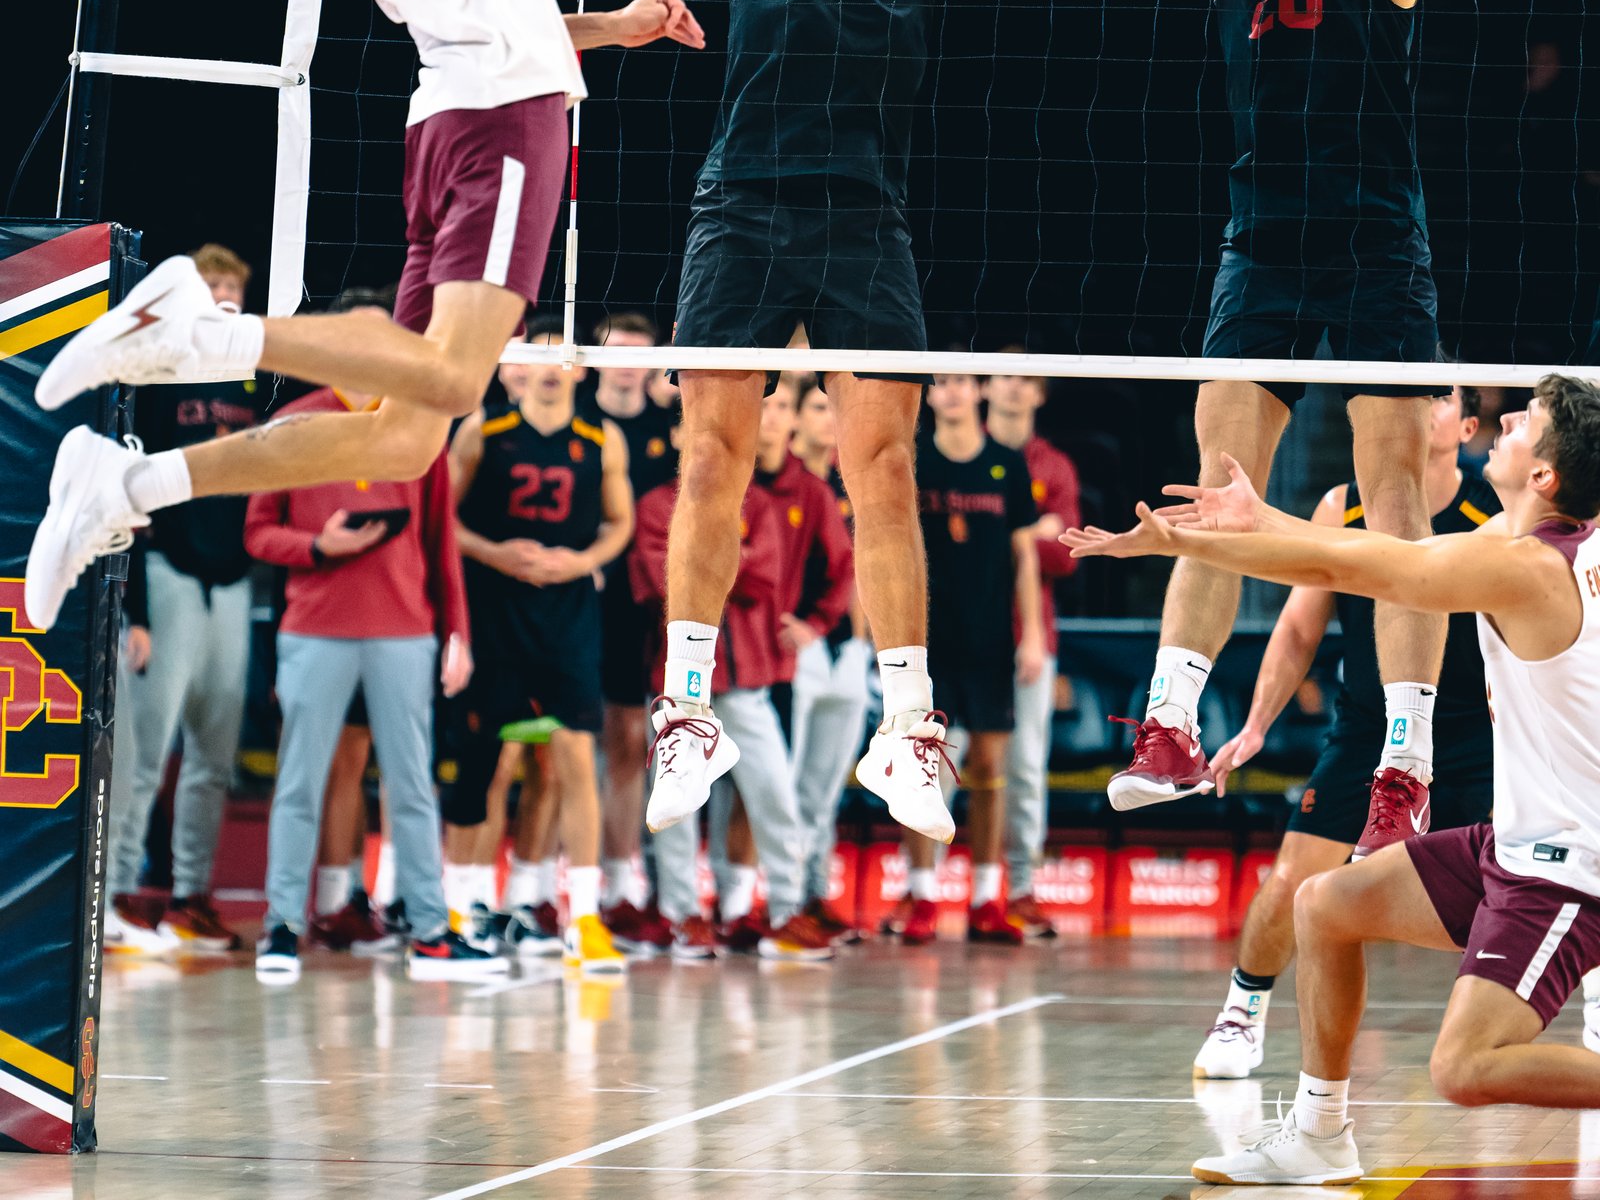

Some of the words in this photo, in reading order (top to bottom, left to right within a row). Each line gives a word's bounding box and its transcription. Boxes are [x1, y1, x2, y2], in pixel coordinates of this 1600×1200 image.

[508, 463, 575, 523] 23
[94, 778, 105, 875] sports
[88, 881, 100, 999] imports
